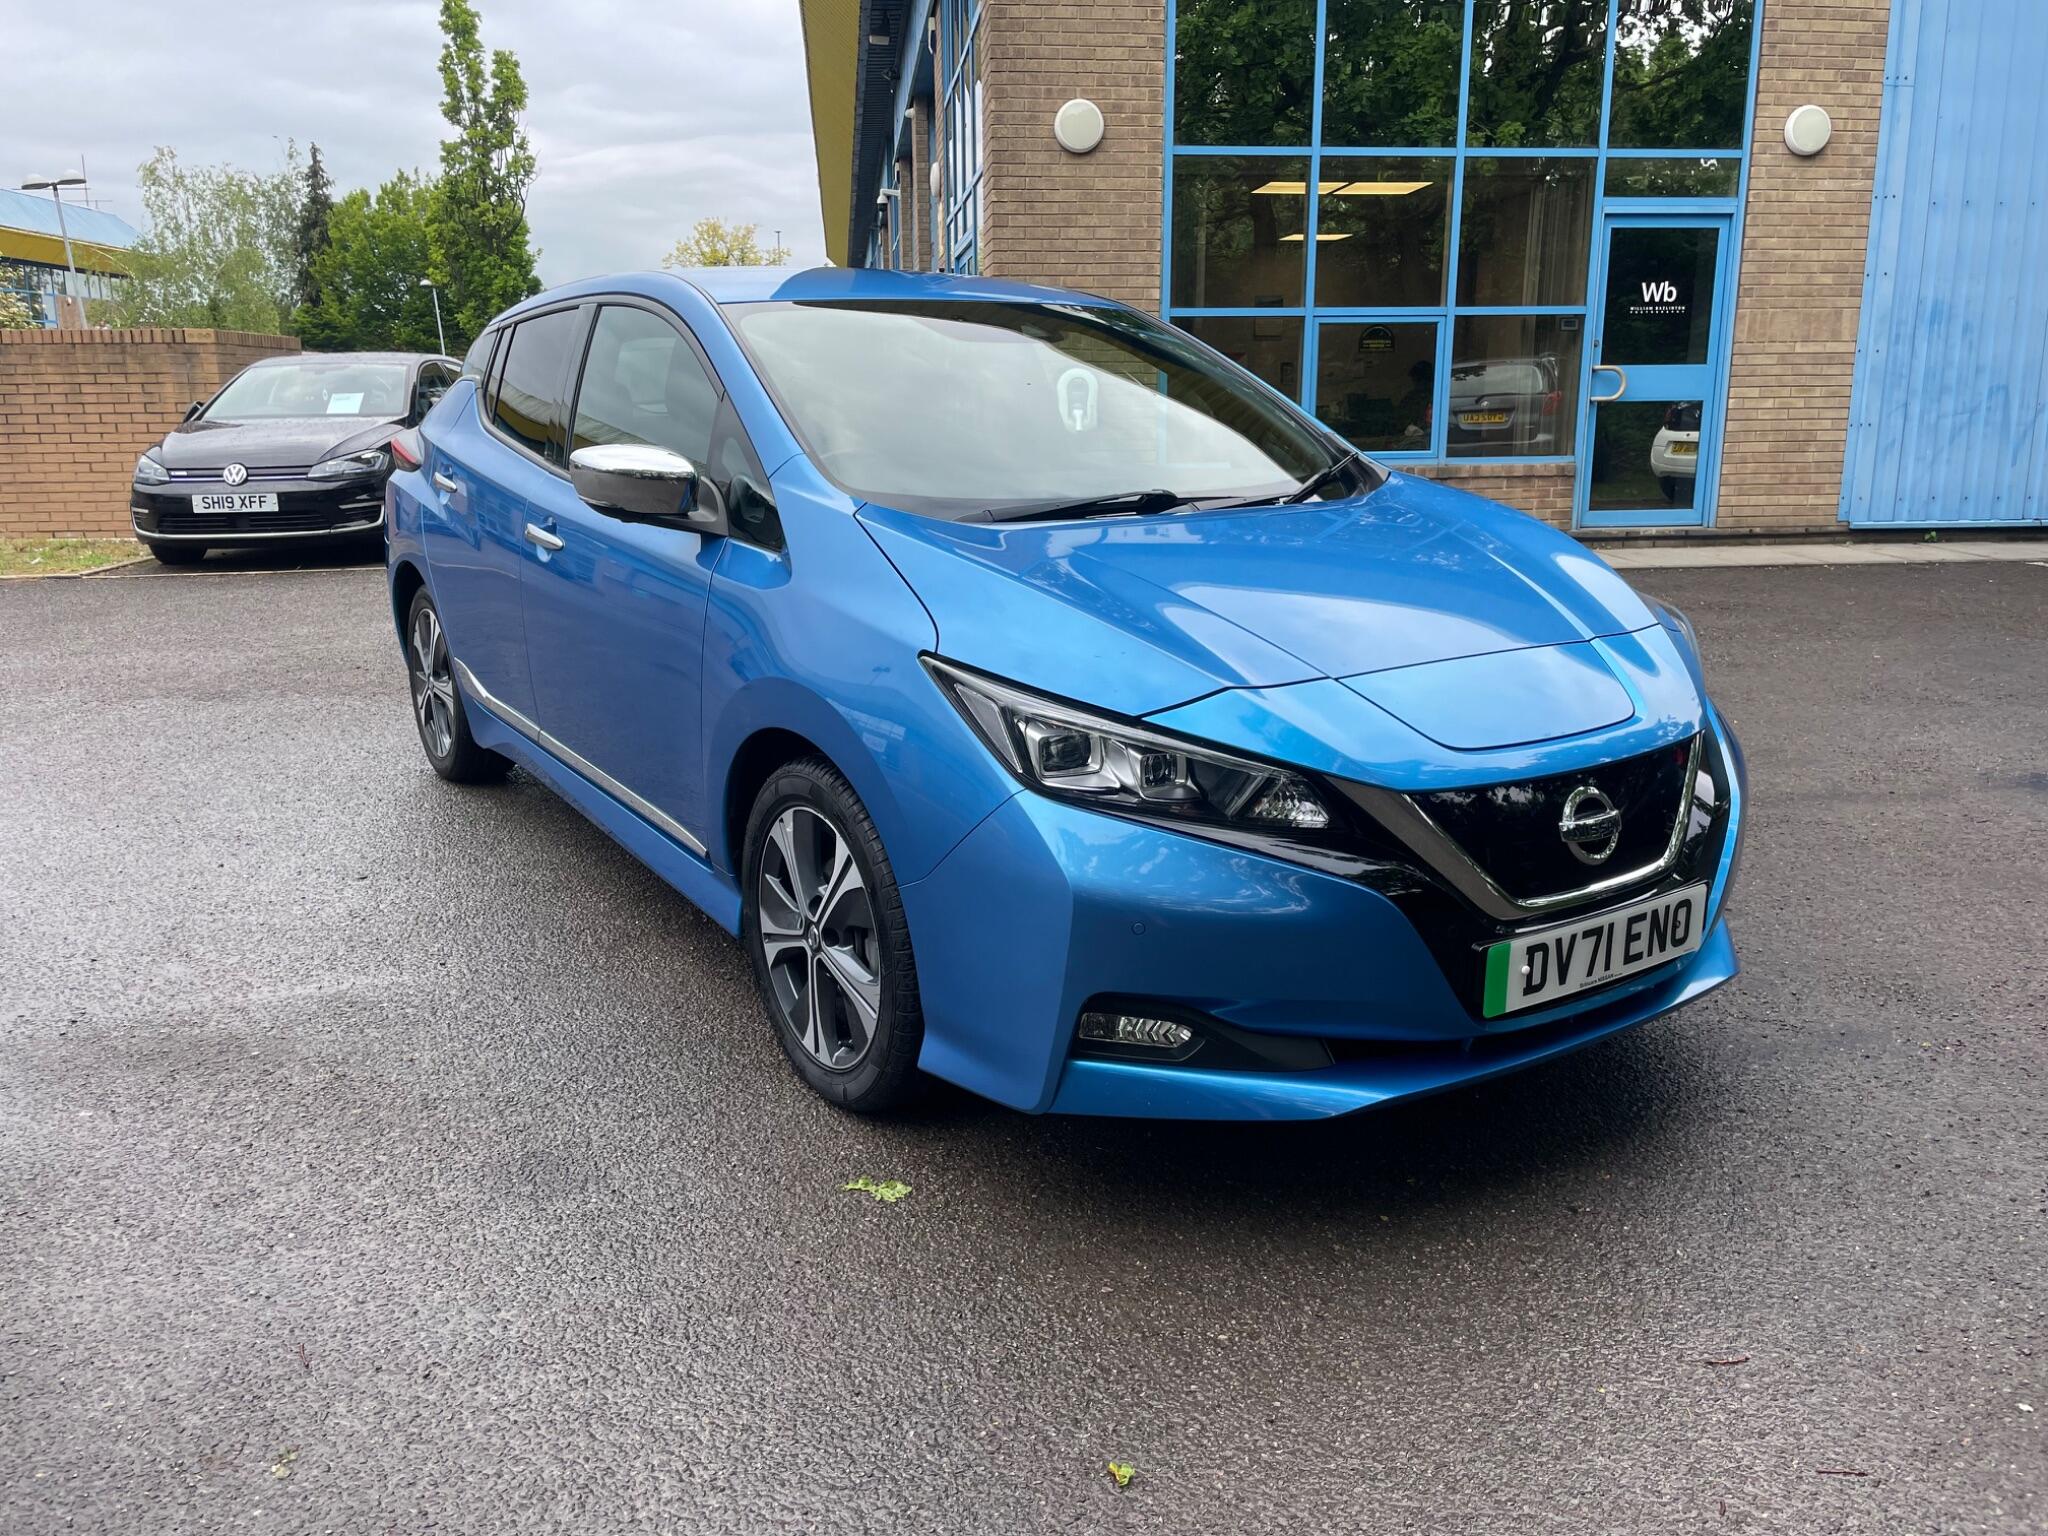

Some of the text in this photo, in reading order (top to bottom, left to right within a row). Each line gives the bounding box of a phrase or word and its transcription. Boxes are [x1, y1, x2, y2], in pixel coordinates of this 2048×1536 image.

[1641, 281, 1677, 303] Wb
[202, 495, 267, 510] SH19 XFF
[1522, 898, 1692, 997] DV71 ENO
